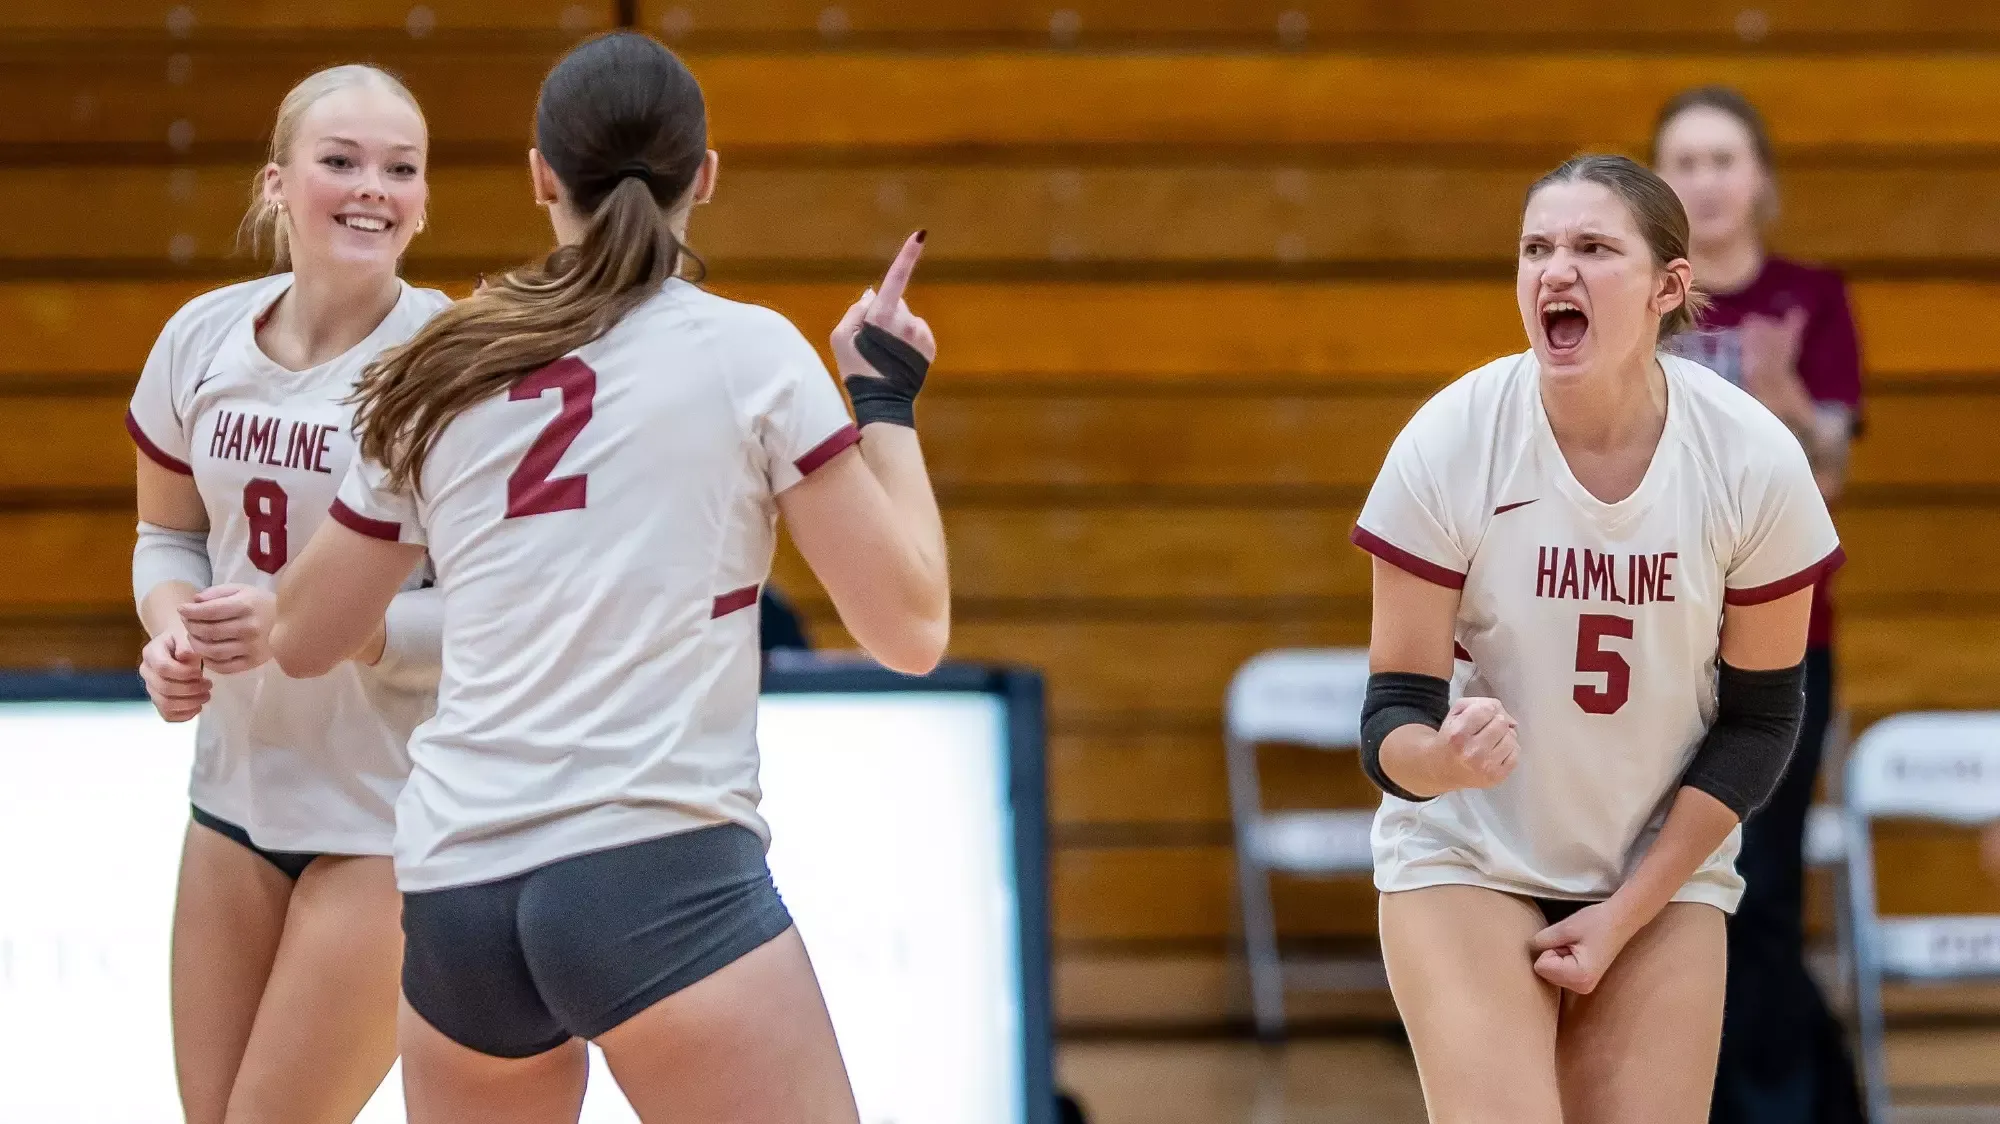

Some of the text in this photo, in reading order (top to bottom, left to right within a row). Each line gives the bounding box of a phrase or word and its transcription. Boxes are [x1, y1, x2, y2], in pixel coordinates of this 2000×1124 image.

[210, 410, 339, 474] HAMLINE
[504, 356, 597, 520] 2
[243, 477, 288, 575] 8
[1536, 546, 1679, 605] HAMLINE
[1573, 613, 1634, 715] 5
